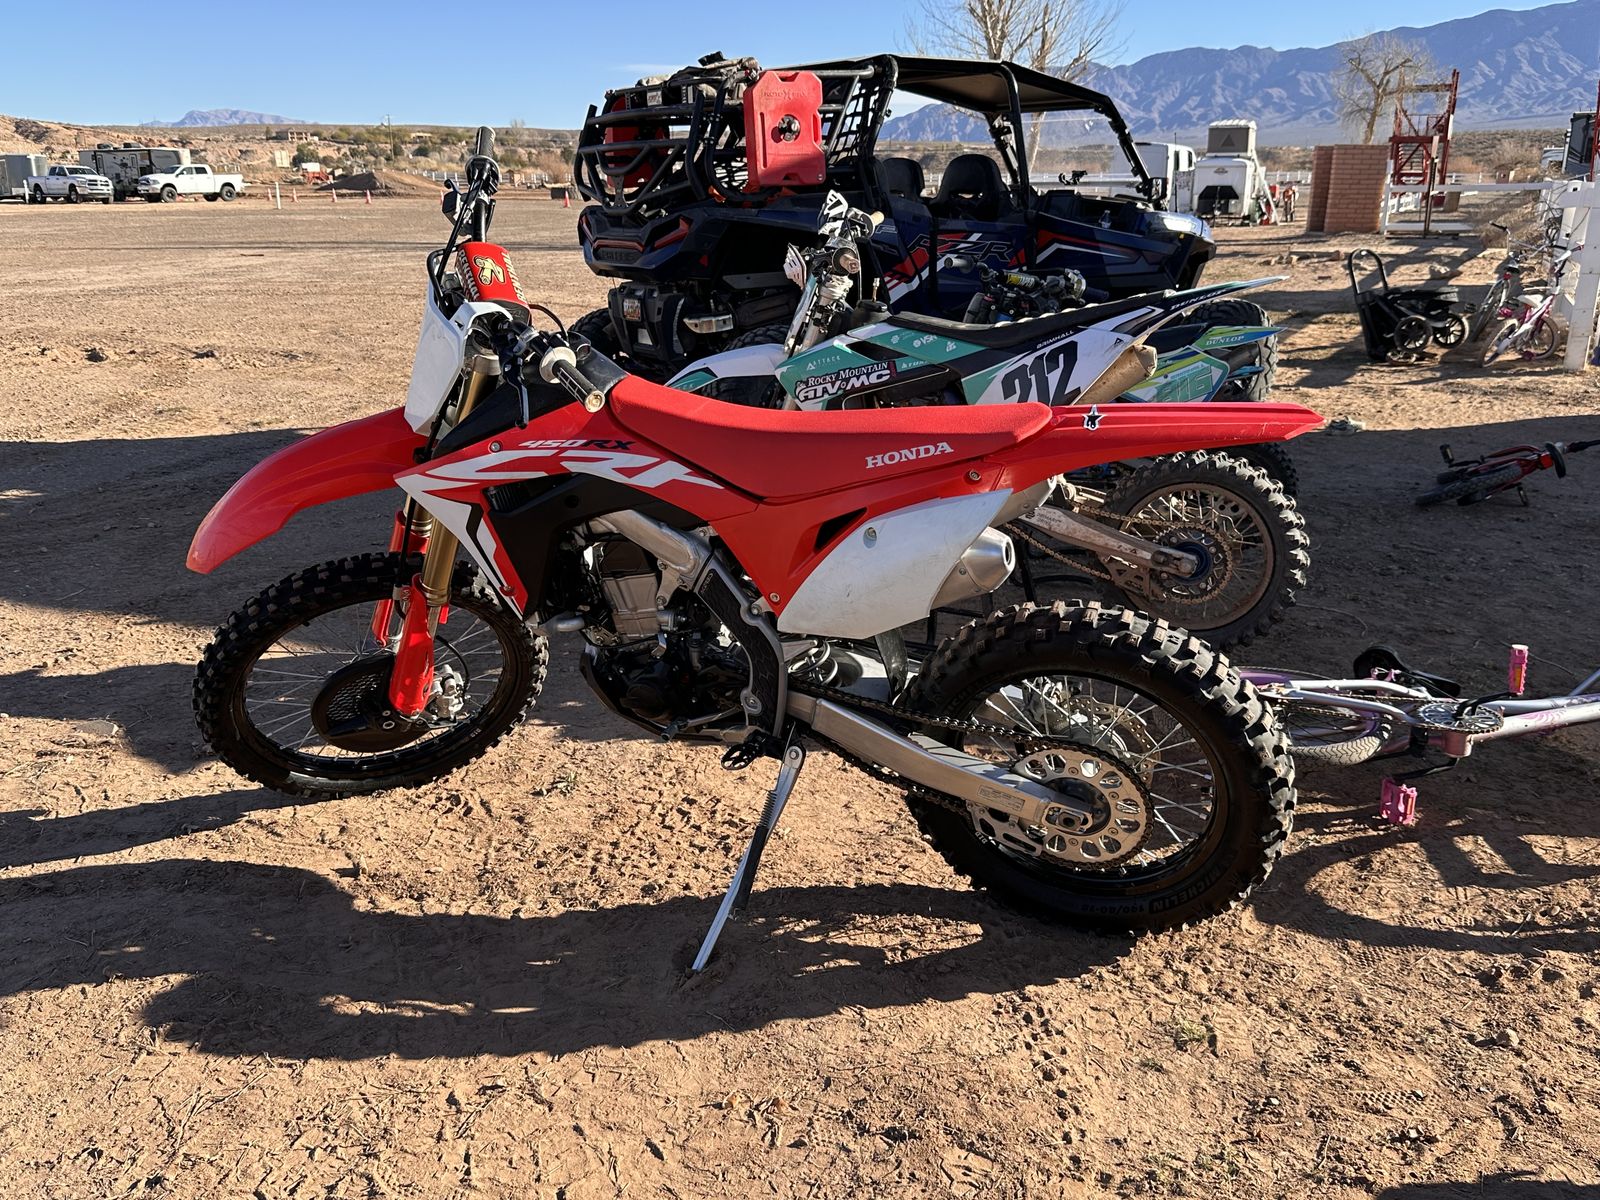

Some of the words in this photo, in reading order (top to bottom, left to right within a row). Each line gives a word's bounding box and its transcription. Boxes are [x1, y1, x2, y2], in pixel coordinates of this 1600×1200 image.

[459, 249, 480, 301] RENTHAL
[1170, 289, 1227, 311] DUNLOP
[1206, 335, 1245, 346] DUNLOP
[807, 373, 837, 388] ROCKY
[838, 361, 889, 380] MOUNTAIN
[1001, 340, 1081, 407] 212
[519, 438, 636, 450] 450RX
[865, 441, 954, 469] HONDA
